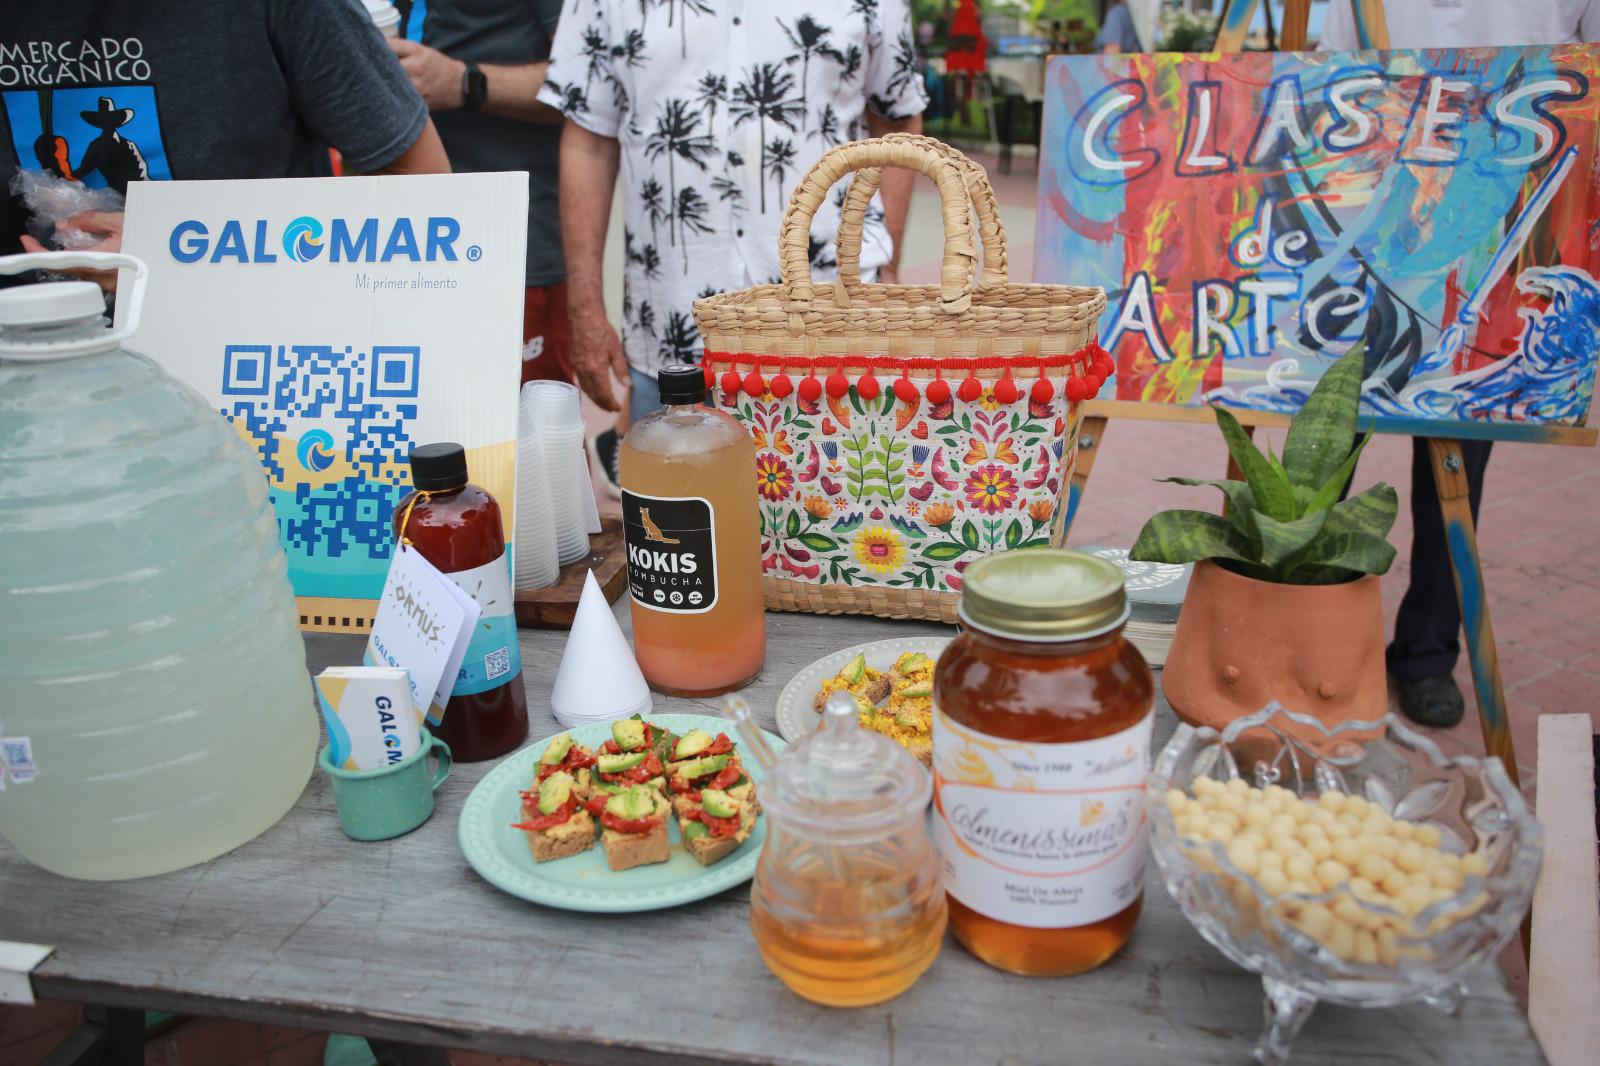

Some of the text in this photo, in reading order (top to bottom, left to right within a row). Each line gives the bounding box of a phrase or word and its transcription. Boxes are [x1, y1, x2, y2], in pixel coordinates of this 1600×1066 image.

[0, 37, 143, 64] MERCADO
[0, 59, 151, 86] ORGÁNICO
[1066, 66, 1589, 185] CLASES
[355, 272, 458, 294] Mi primer alimento
[628, 542, 698, 574] KOKIS
[629, 565, 702, 586] KOMBUCHA
